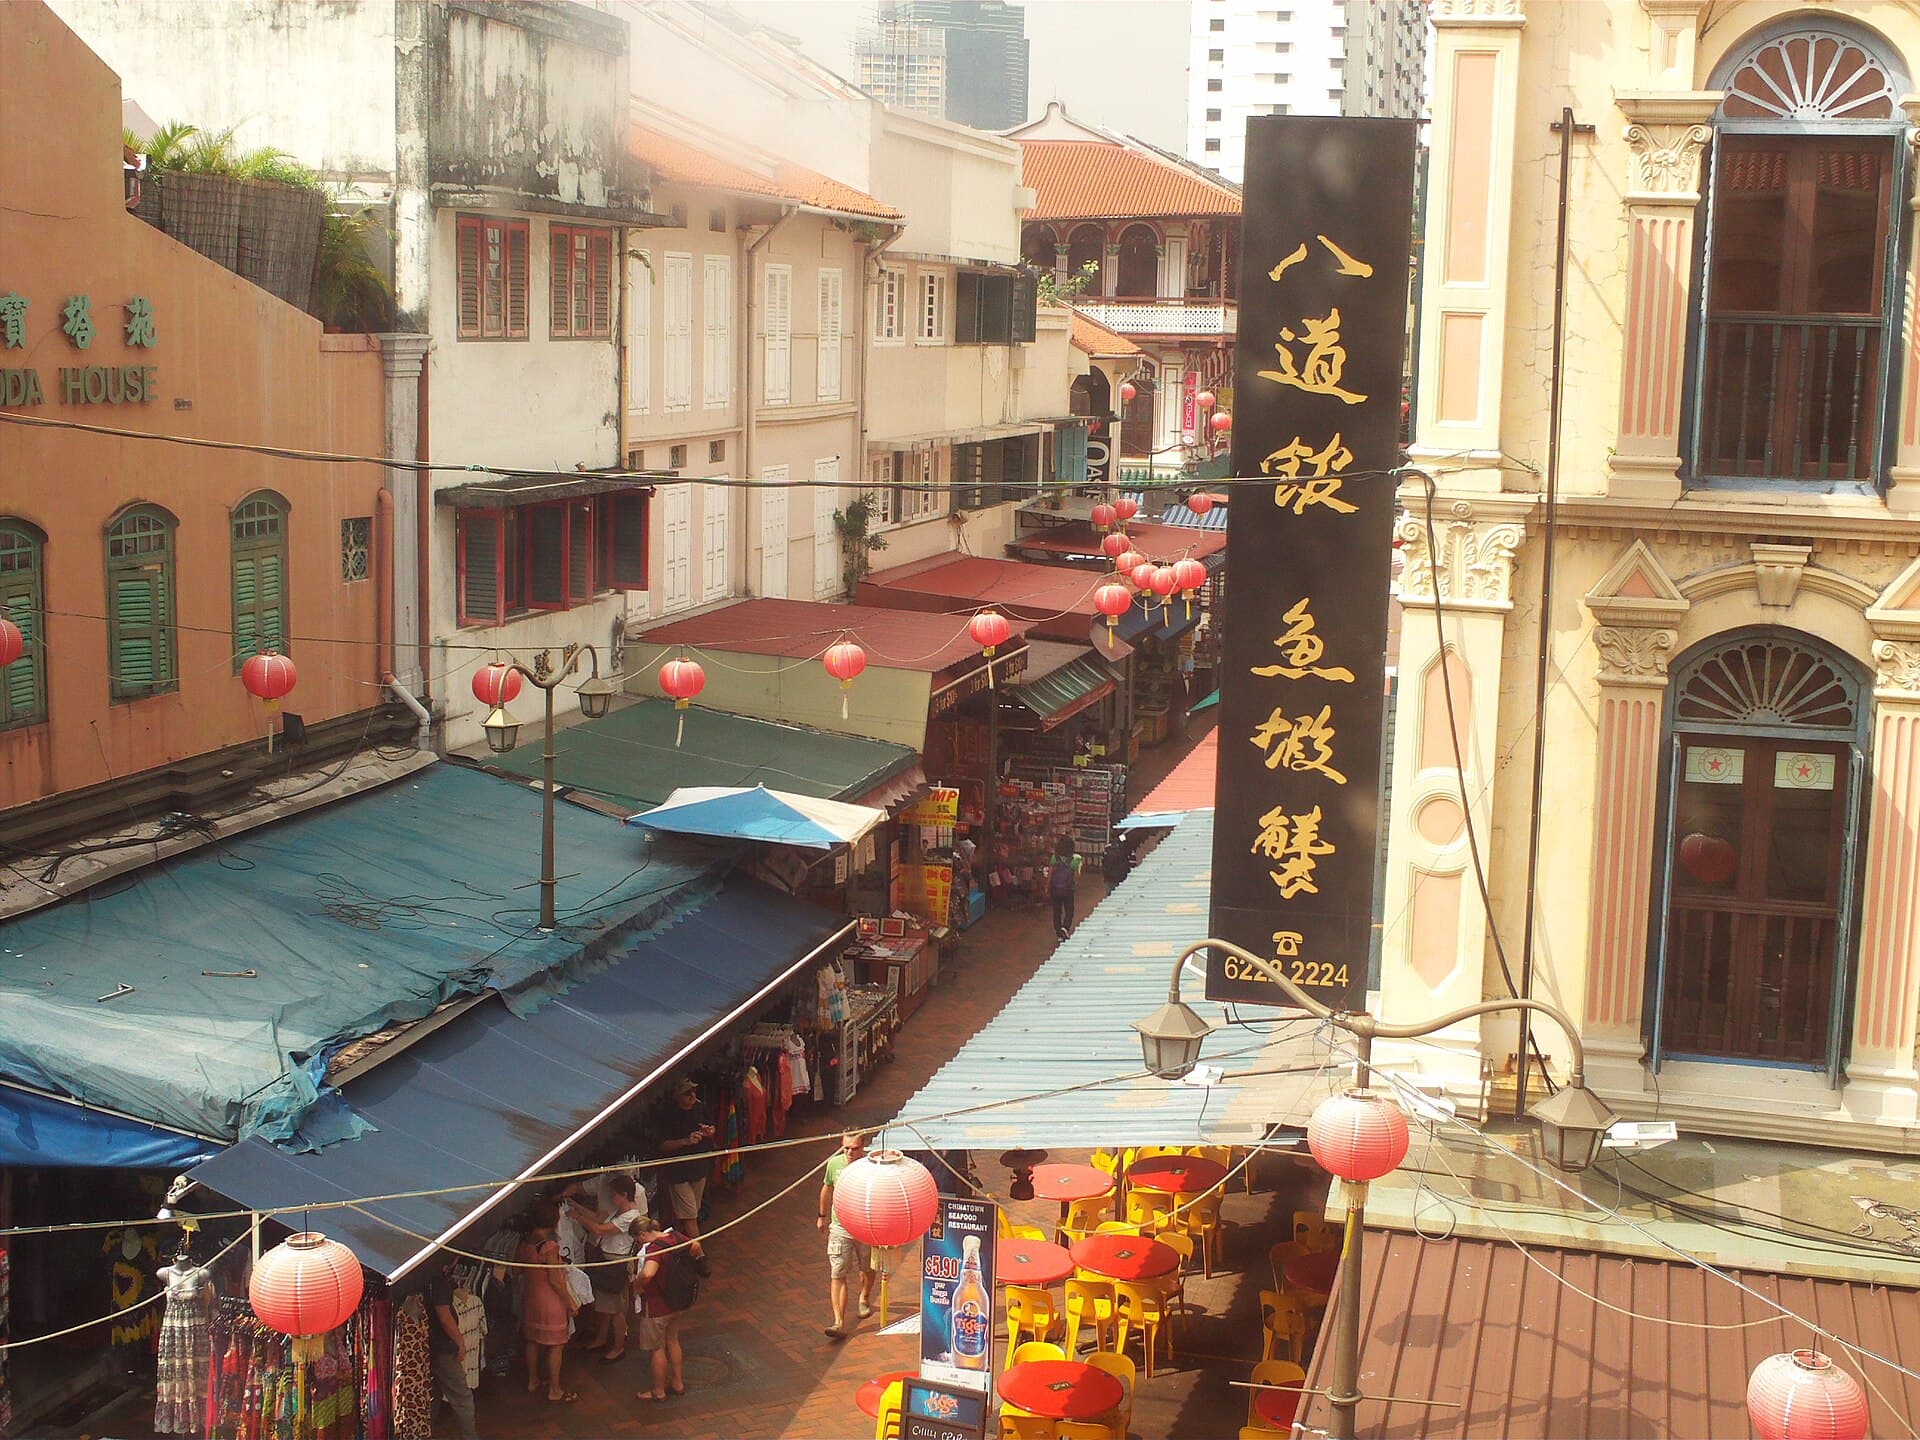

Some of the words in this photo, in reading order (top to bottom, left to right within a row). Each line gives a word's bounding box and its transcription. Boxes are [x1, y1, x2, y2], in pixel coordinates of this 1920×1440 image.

[62, 365, 158, 405] HOUSE
[1290, 960, 1349, 988] 2224
[947, 1202, 985, 1212] CHINATOWN
[948, 1212, 978, 1221] SEAFOOD
[948, 1221, 988, 1232] RESTAURANT
[925, 1255, 959, 1279] $5.90
[955, 1317, 986, 1336] Tiger
[924, 1394, 959, 1414] Tiger
